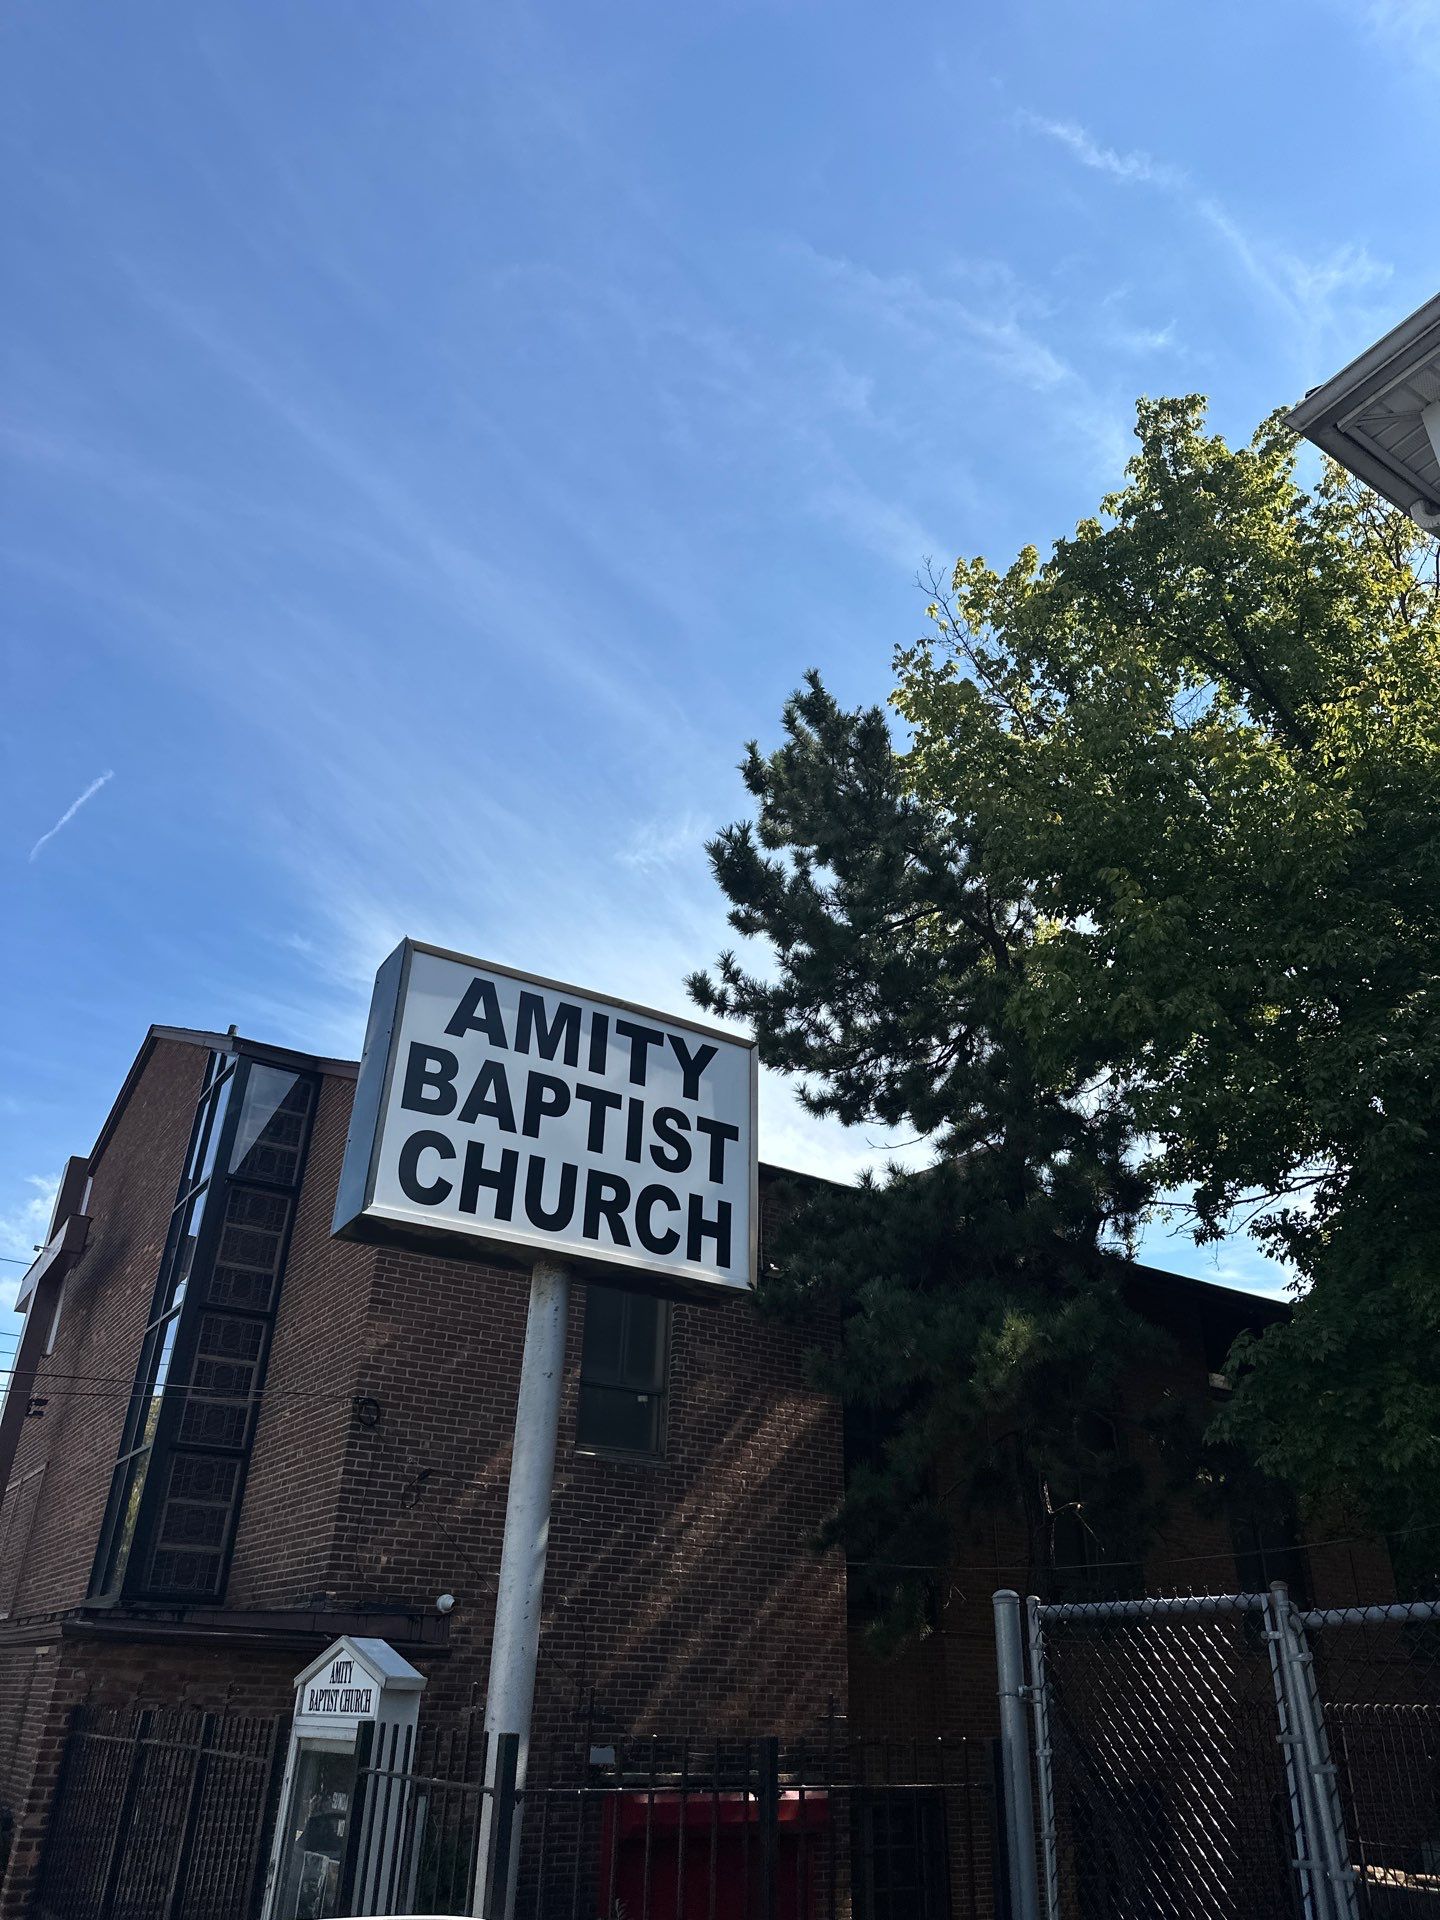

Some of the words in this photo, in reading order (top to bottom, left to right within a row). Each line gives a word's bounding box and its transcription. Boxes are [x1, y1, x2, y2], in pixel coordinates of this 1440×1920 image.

[444, 977, 719, 1101] AMITY
[401, 1041, 739, 1184] BAPTIST
[399, 1130, 732, 1269] CHURCH
[309, 1689, 340, 1712] BAPTIST
[340, 1689, 372, 1713] CHURCH
[329, 1661, 354, 1684] AMITY
